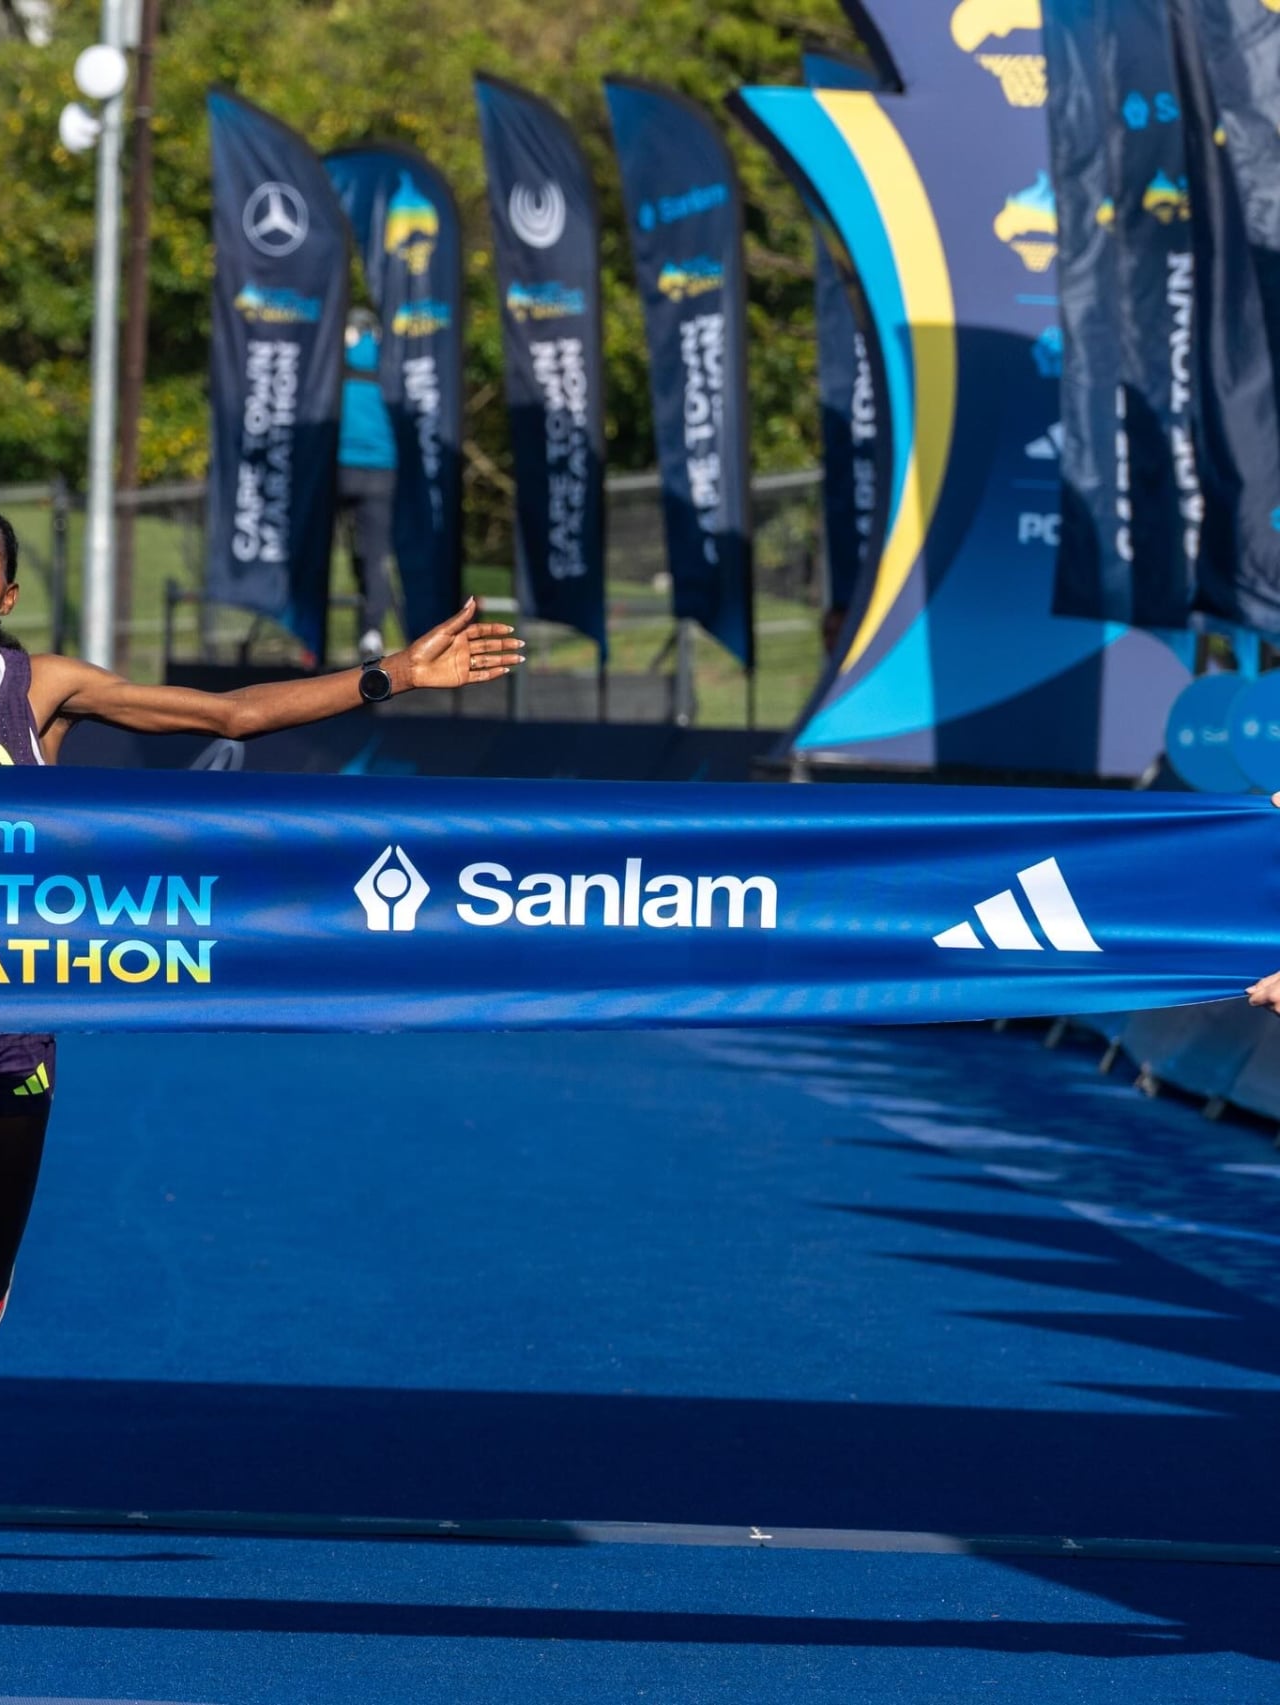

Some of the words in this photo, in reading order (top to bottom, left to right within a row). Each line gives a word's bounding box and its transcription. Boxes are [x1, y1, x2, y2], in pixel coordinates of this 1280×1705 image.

[243, 340, 272, 455] TOWN
[260, 339, 301, 562] MARATHON
[530, 342, 571, 466] TOWN
[231, 462, 267, 563] CAPE
[548, 474, 574, 580] CAPE
[456, 857, 778, 929] Sanlam
